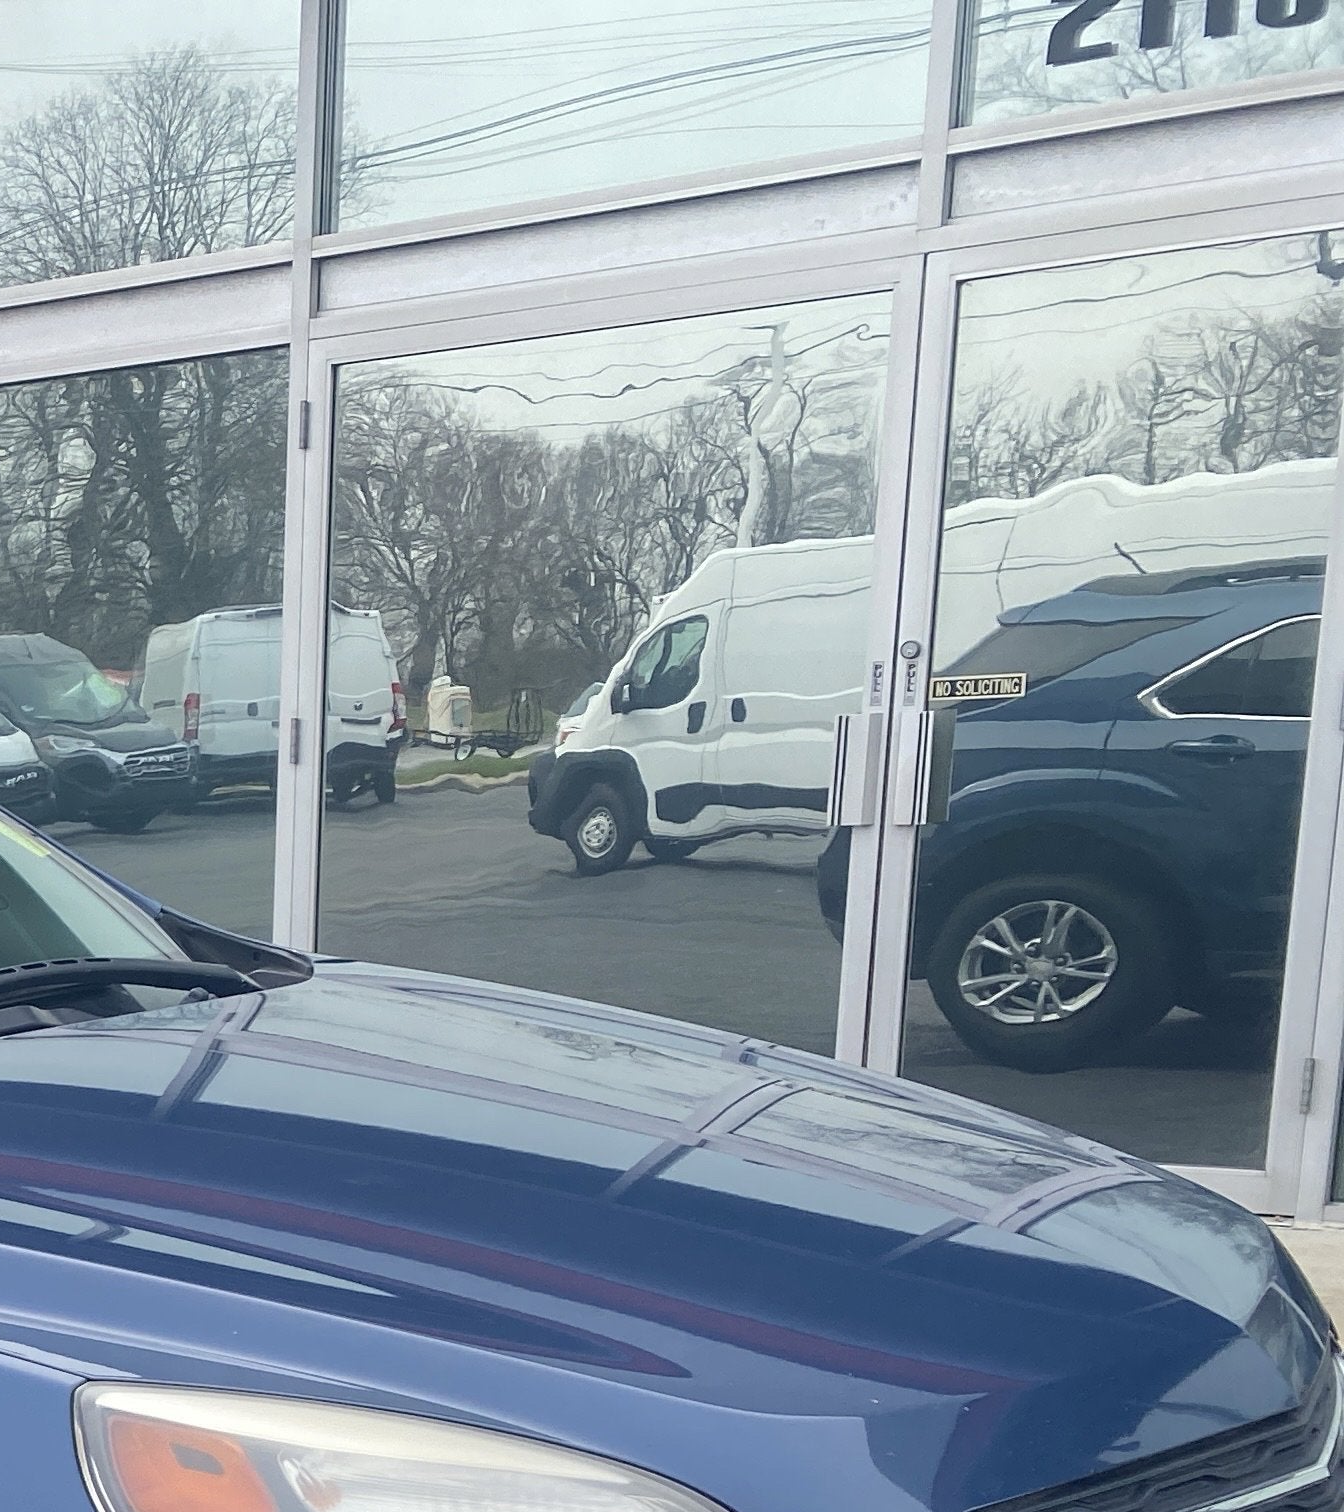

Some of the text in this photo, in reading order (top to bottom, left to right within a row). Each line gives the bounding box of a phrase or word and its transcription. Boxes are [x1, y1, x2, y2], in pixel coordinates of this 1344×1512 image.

[1046, 0, 1328, 66] 21
[935, 677, 1020, 697] NO SOLICITING
